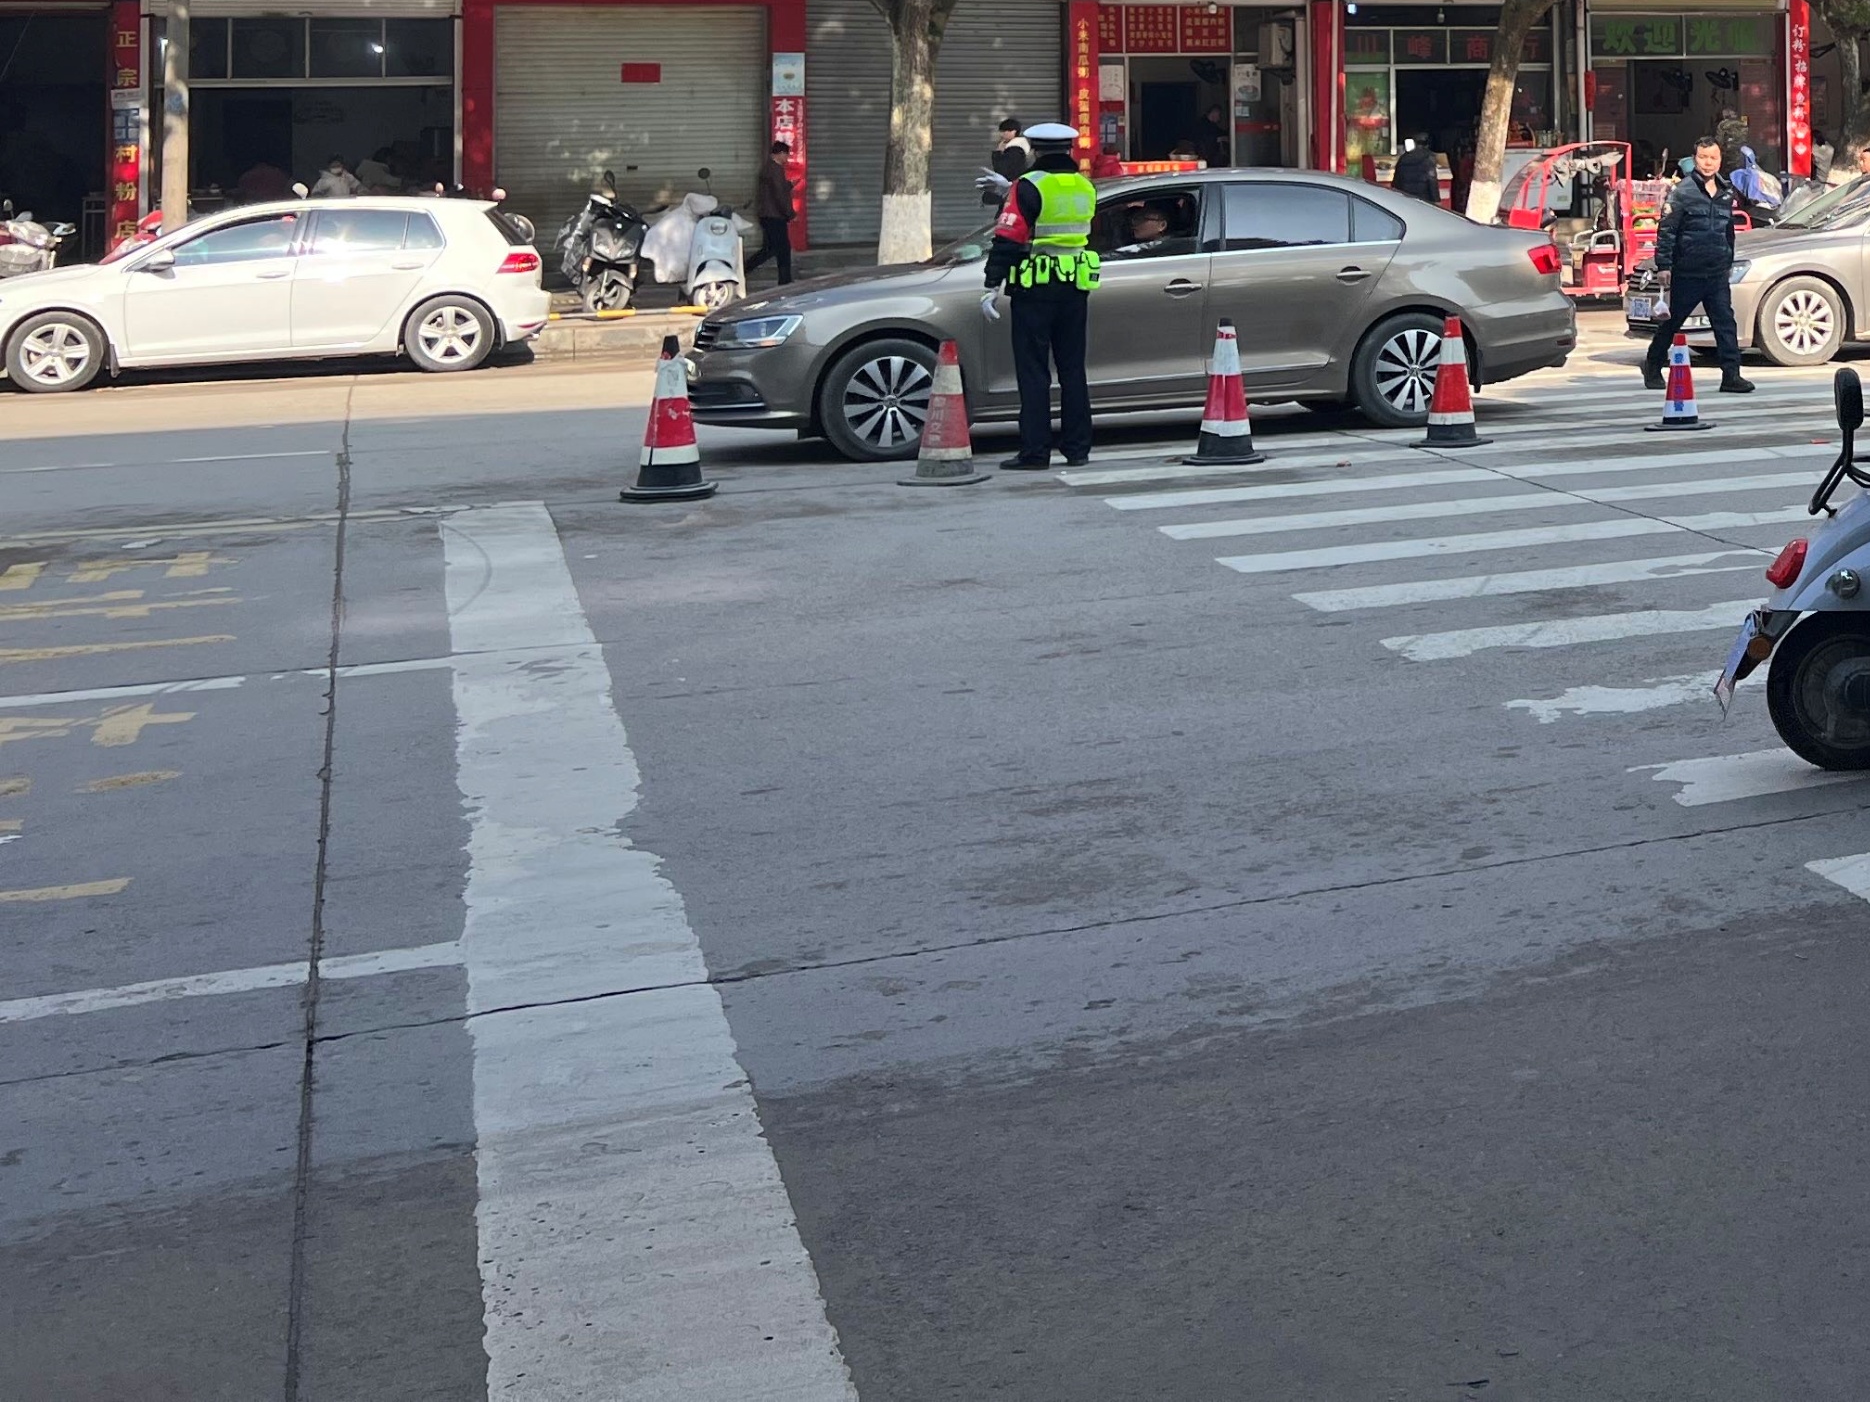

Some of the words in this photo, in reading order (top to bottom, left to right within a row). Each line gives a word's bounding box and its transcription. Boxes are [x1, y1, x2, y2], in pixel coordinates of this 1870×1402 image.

[115, 30, 138, 239] 正宗村粉店
